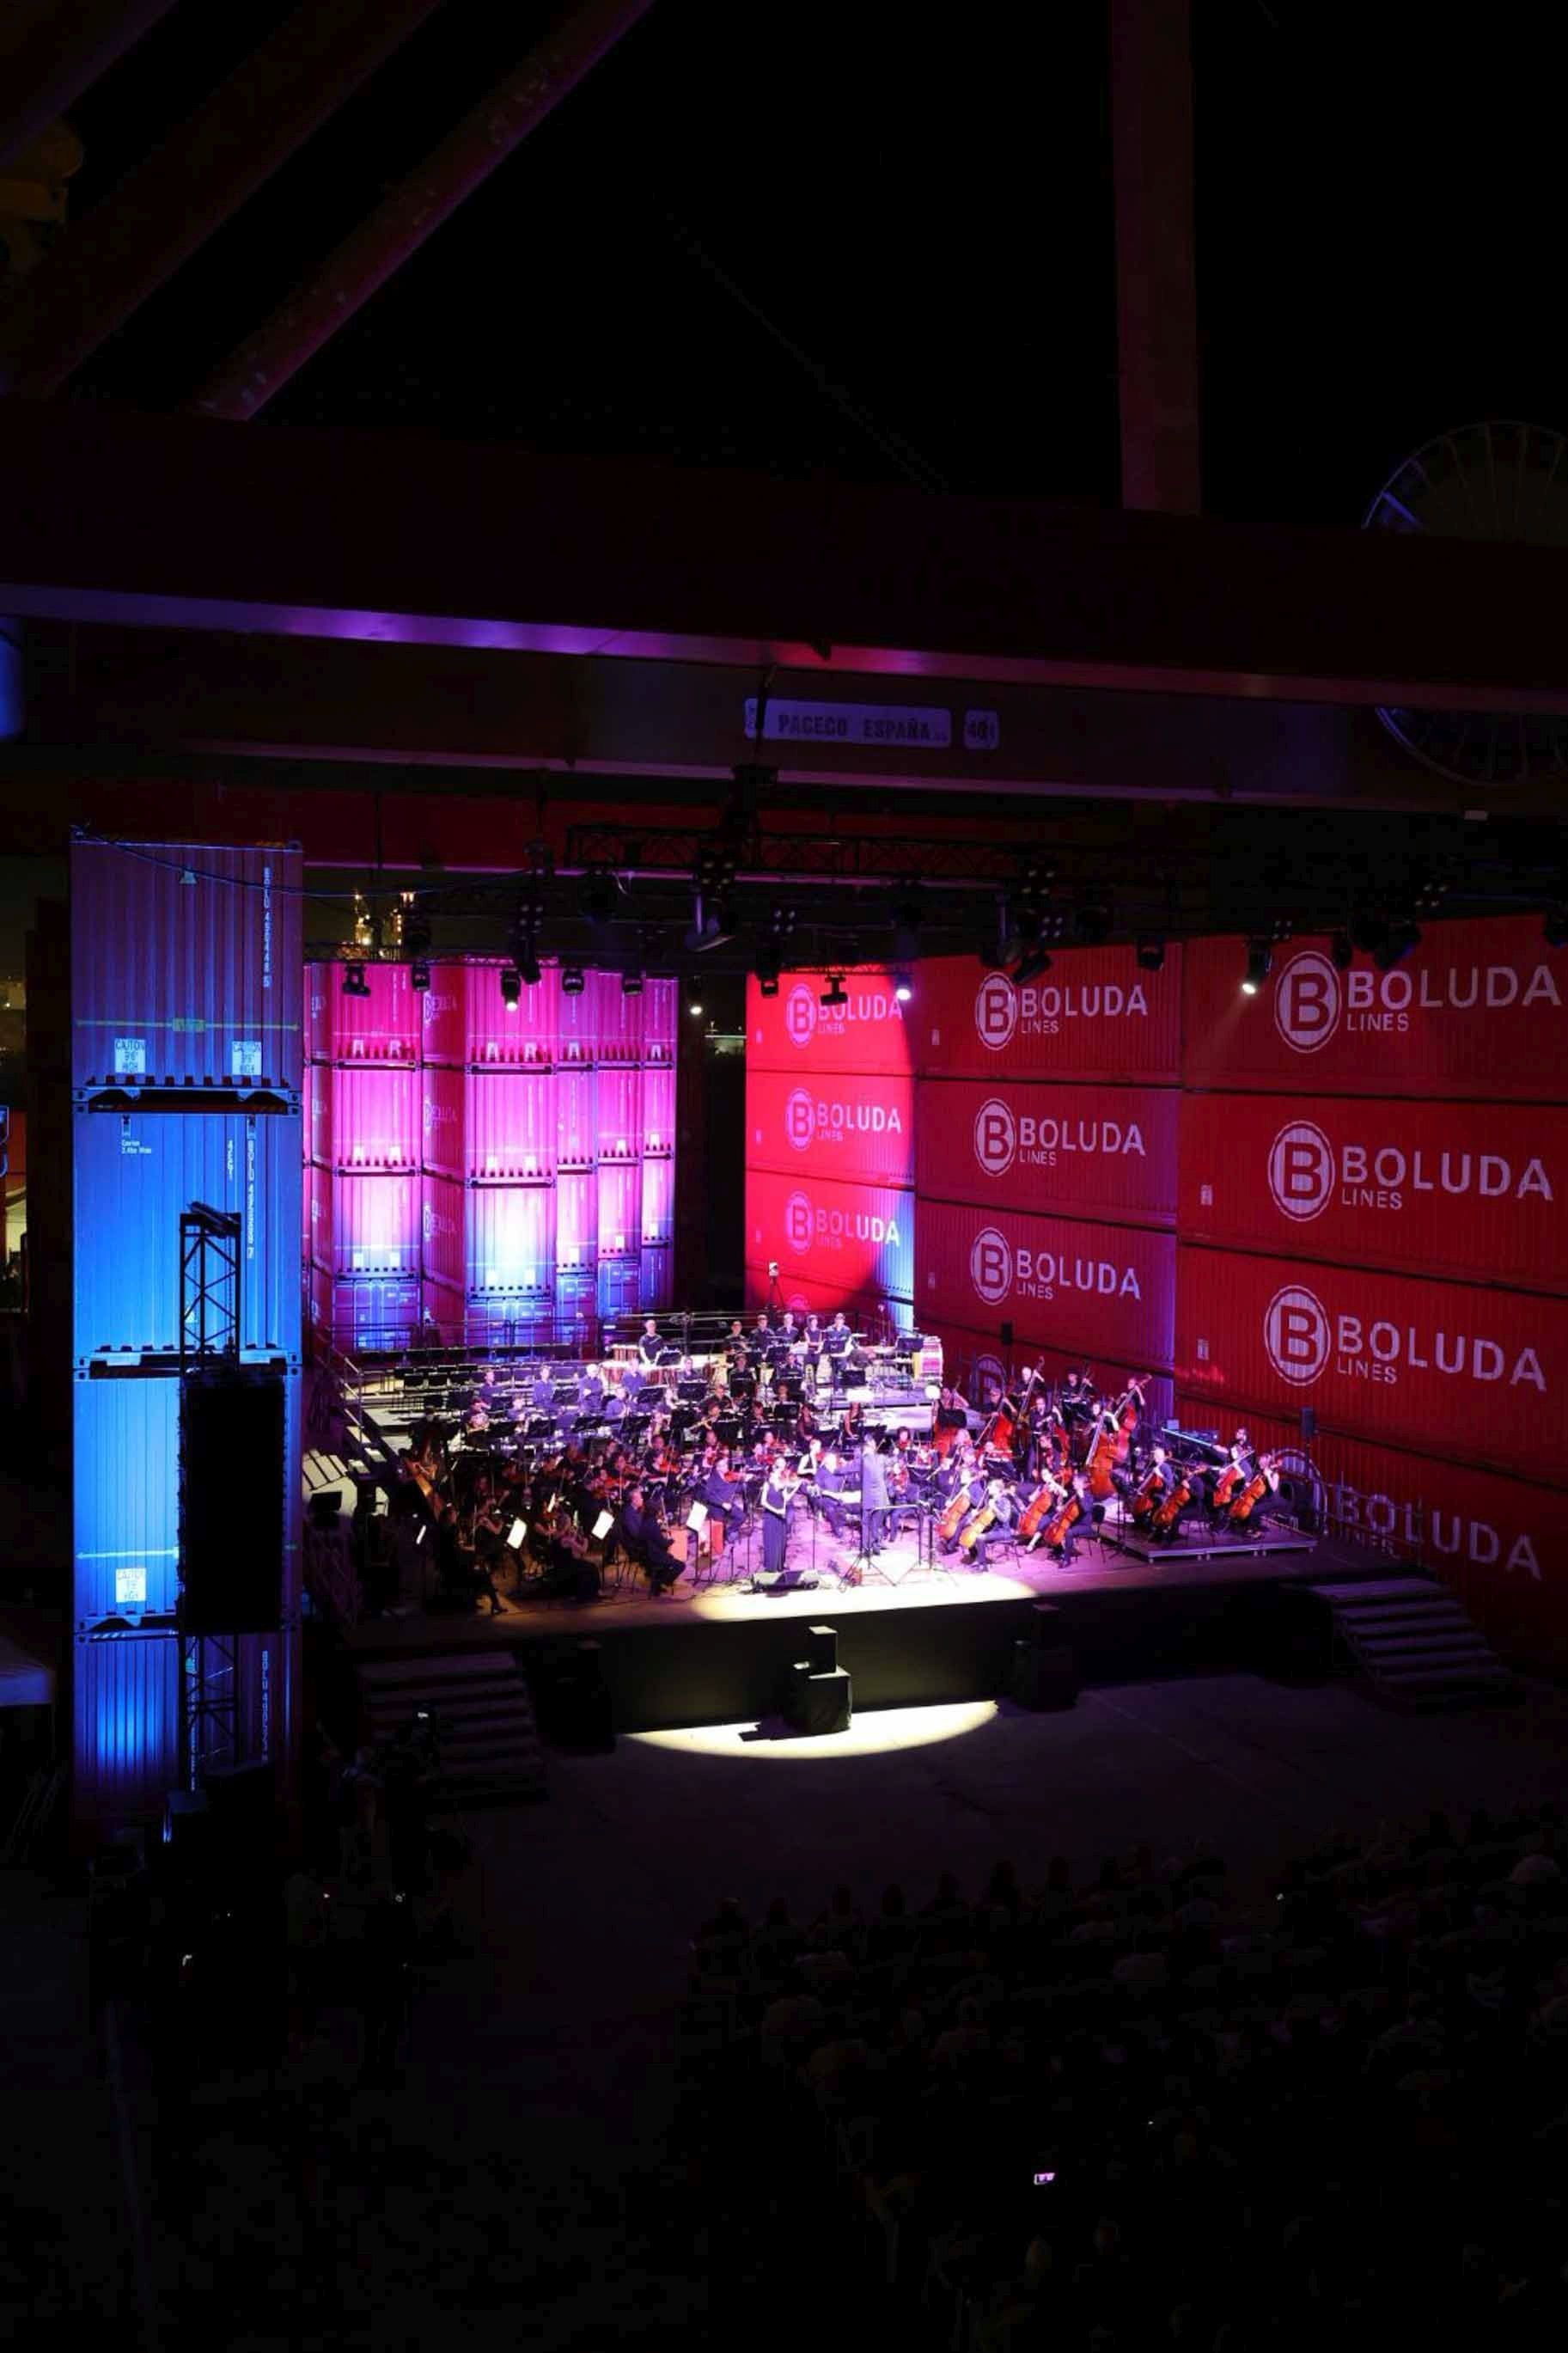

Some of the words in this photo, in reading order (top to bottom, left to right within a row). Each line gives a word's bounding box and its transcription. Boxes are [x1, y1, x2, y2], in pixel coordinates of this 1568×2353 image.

[1021, 984, 1148, 1018] BOLUDA
[1346, 965, 1561, 1011] BOLUDA
[1021, 1020, 1059, 1035] LINES
[1346, 1012, 1410, 1033] LINES
[817, 1103, 901, 1134] BOLUDA
[1019, 1117, 1147, 1157] BOLUDA
[1020, 1150, 1058, 1167] LINES
[1341, 1145, 1554, 1202] BOLUDA
[1341, 1188, 1403, 1211] LINES
[816, 1209, 900, 1246] BOLUDA
[1016, 1252, 1142, 1300] BOLUDA
[1017, 1283, 1054, 1300] LINES
[1337, 1314, 1547, 1392] BOLUDA
[1337, 1354, 1398, 1385] LINES
[1337, 1488, 1542, 1580] BOLUDA
